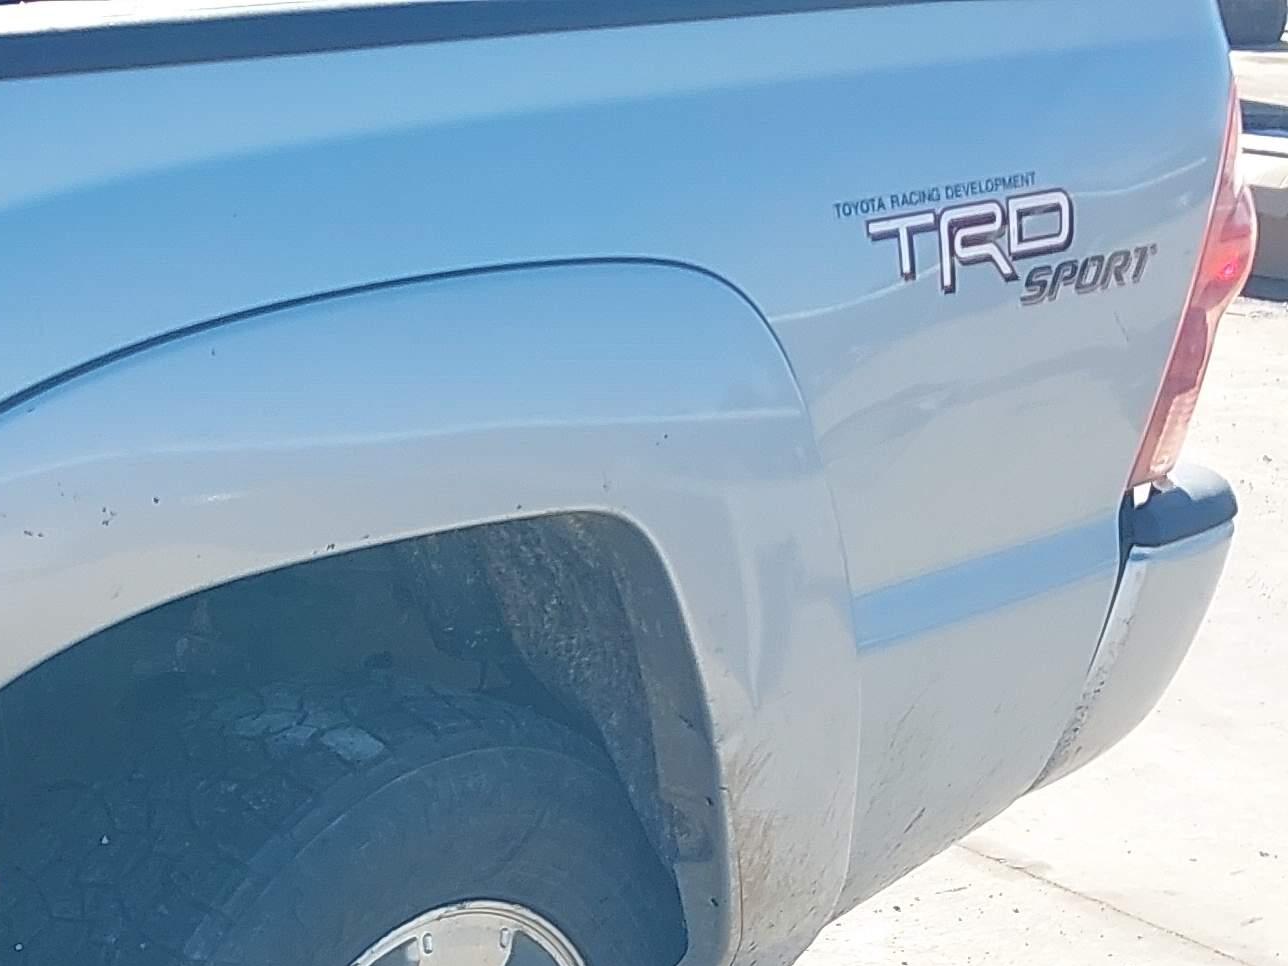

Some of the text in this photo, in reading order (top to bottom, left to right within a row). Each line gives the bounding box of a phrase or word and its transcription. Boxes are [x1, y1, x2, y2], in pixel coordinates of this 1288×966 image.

[833, 171, 1037, 218] TOYOTA RACING DEVELOPMENT
[865, 187, 1075, 294] TRD
[1019, 246, 1150, 306] SPORT
